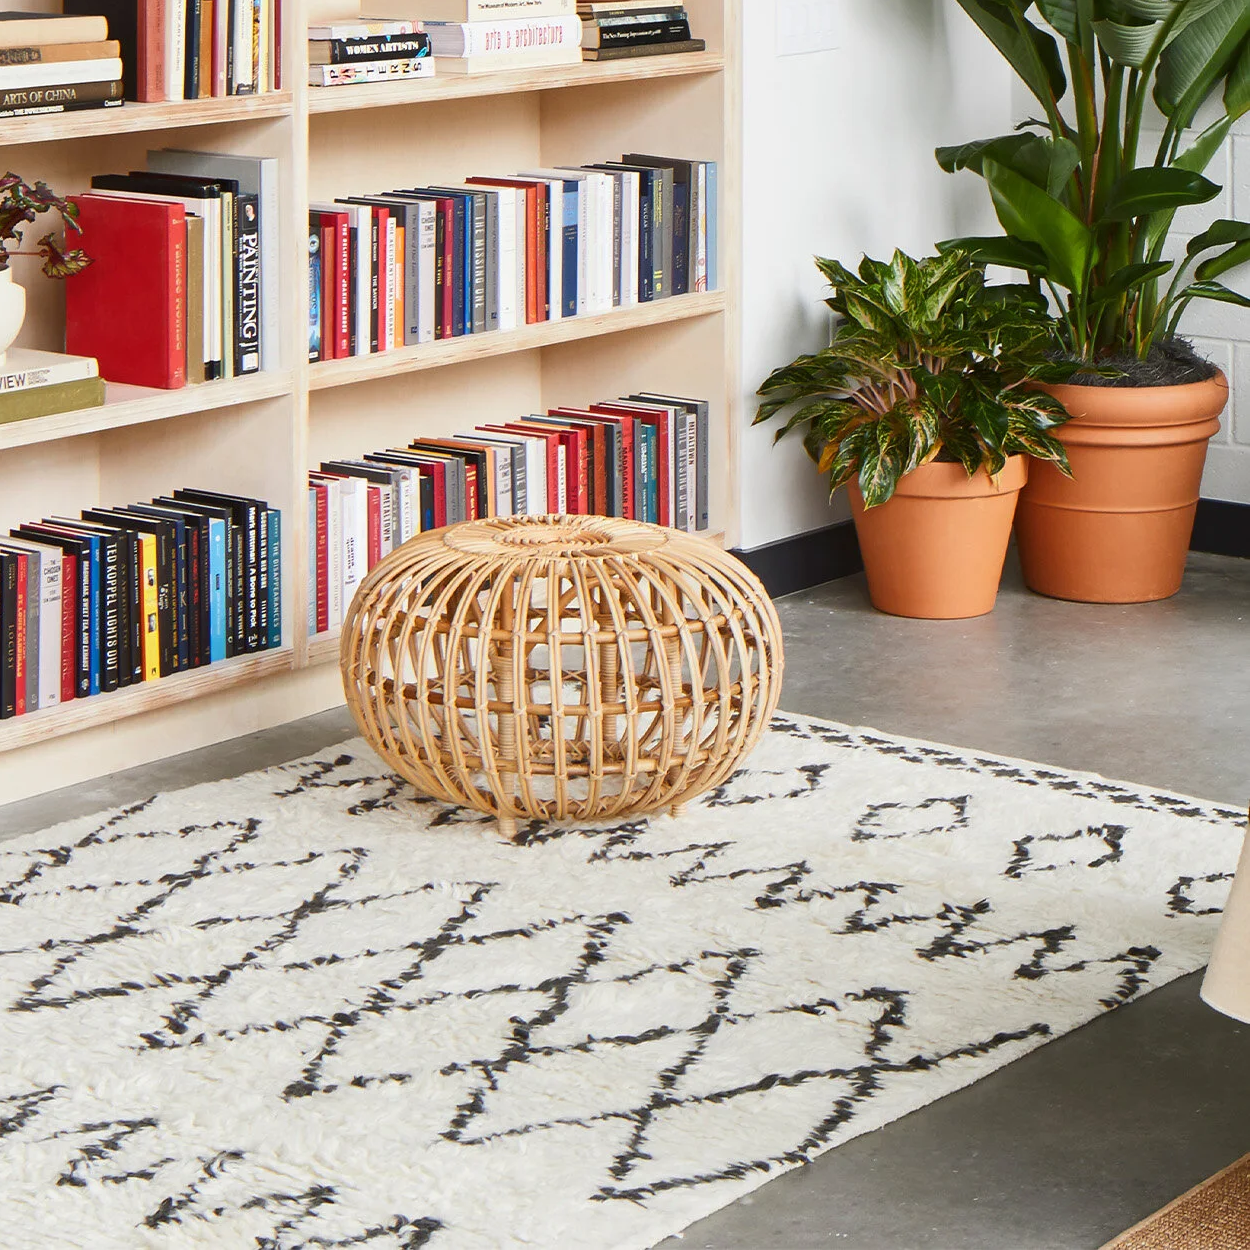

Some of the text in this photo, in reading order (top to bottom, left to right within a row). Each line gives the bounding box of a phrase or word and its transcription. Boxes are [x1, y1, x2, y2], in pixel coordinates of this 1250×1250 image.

[347, 40, 418, 56] WOMEN ARTISTS
[329, 62, 422, 78] PATTERNS
[3, 89, 77, 105] ARTS OF CHINA
[243, 233, 257, 338] PAINTING
[383, 493, 391, 542] METALTOWN
[107, 543, 117, 670] TED KOPPEL LIGHTS OUT
[250, 600, 255, 608] to
